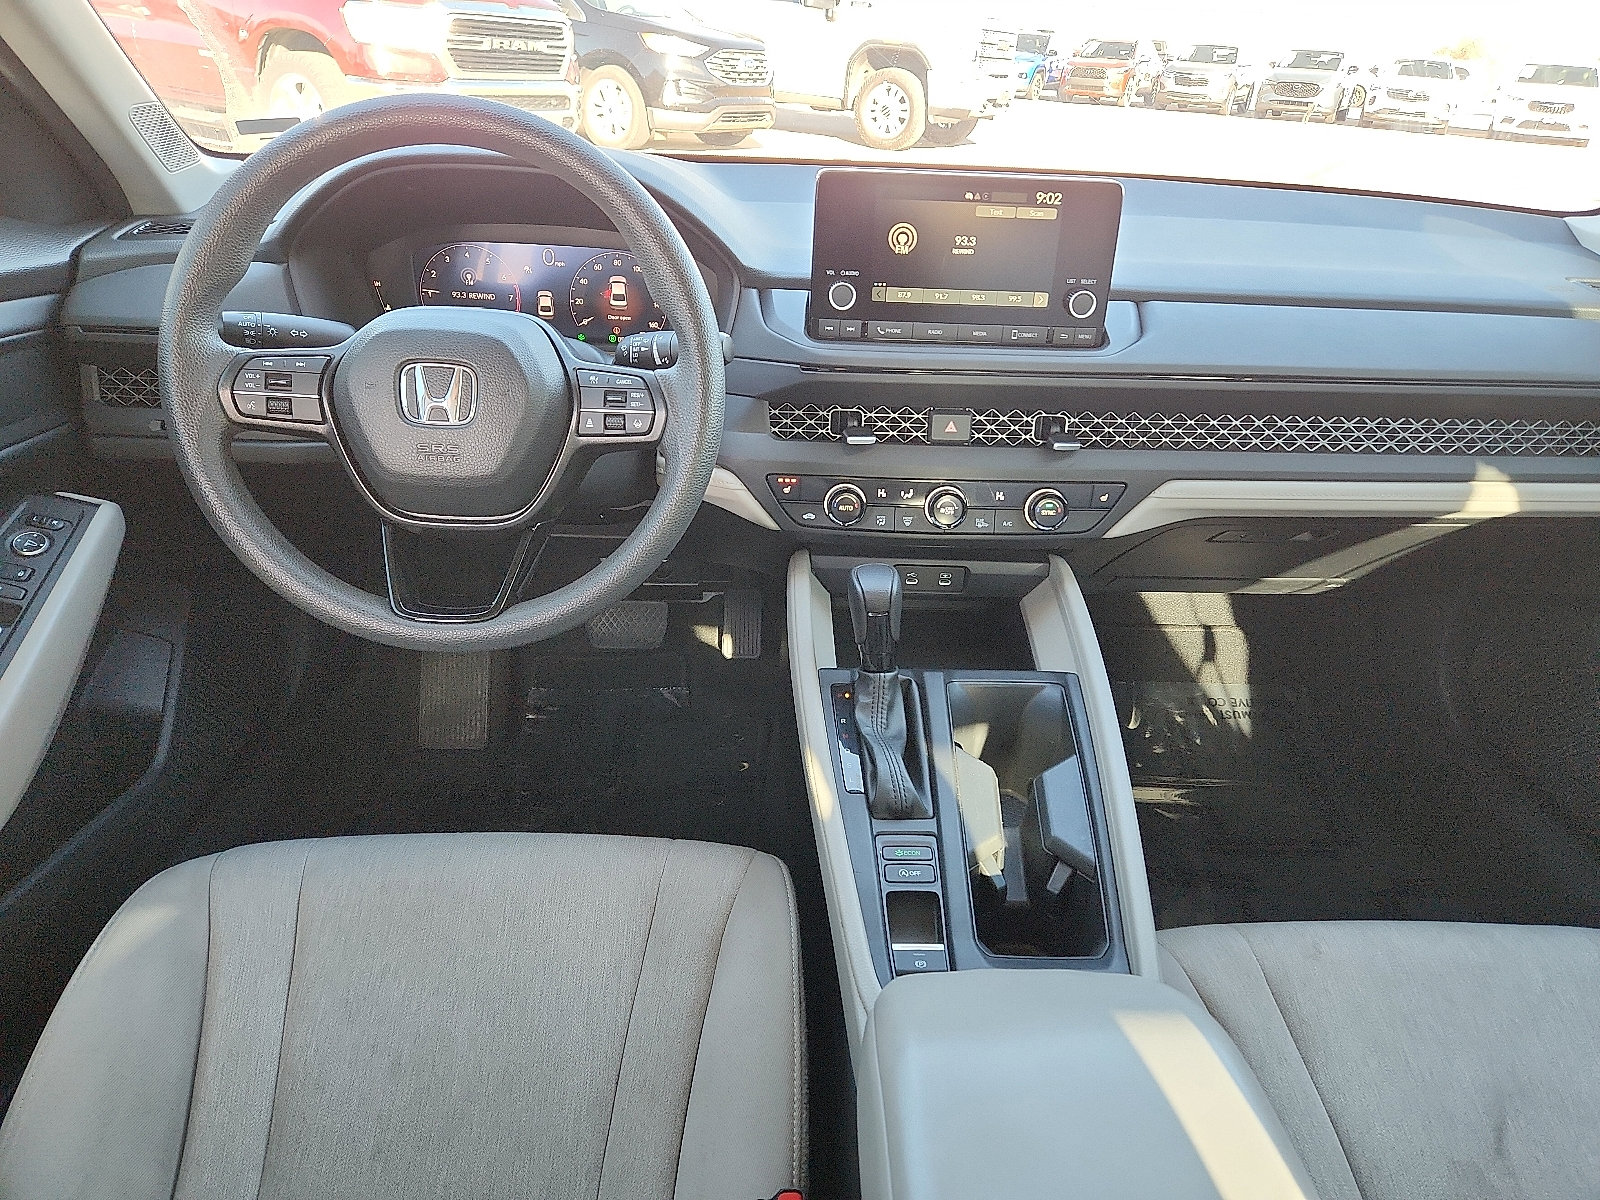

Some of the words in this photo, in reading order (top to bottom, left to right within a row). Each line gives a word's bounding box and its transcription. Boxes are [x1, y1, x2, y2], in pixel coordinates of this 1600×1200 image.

[492, 39, 542, 53] RAM
[1036, 192, 1062, 205] 9:02
[954, 236, 976, 246] 93.3
[593, 263, 602, 271] 60
[430, 270, 437, 278] 2
[451, 291, 467, 299] 93.3
[468, 292, 496, 300] REWIND
[416, 443, 459, 453] SRS
[417, 454, 461, 462] AIRBAG
